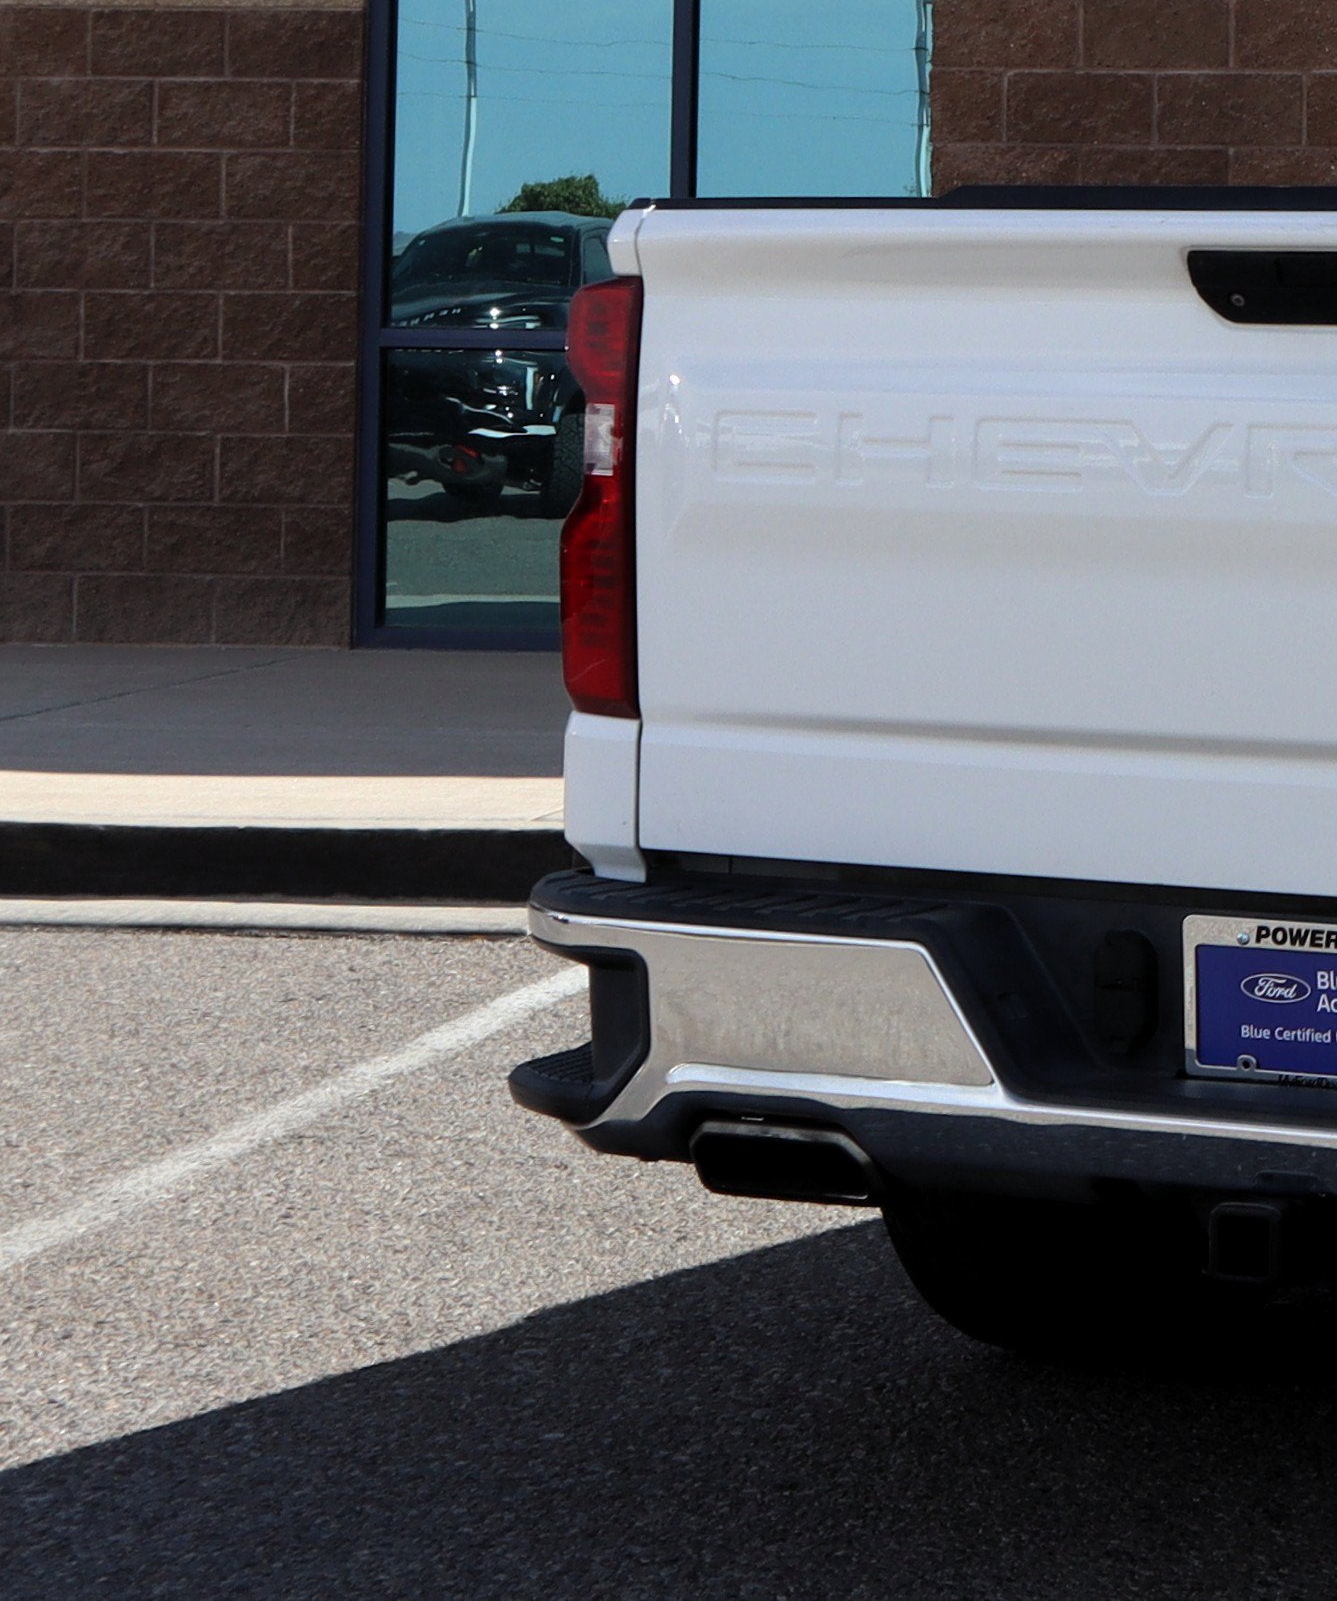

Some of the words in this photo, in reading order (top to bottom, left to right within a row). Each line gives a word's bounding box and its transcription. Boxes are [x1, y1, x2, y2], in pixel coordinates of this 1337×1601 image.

[1254, 975, 1297, 999] Ford
[1241, 1025, 1270, 1040] Blue
[1275, 1027, 1331, 1044] Certified
